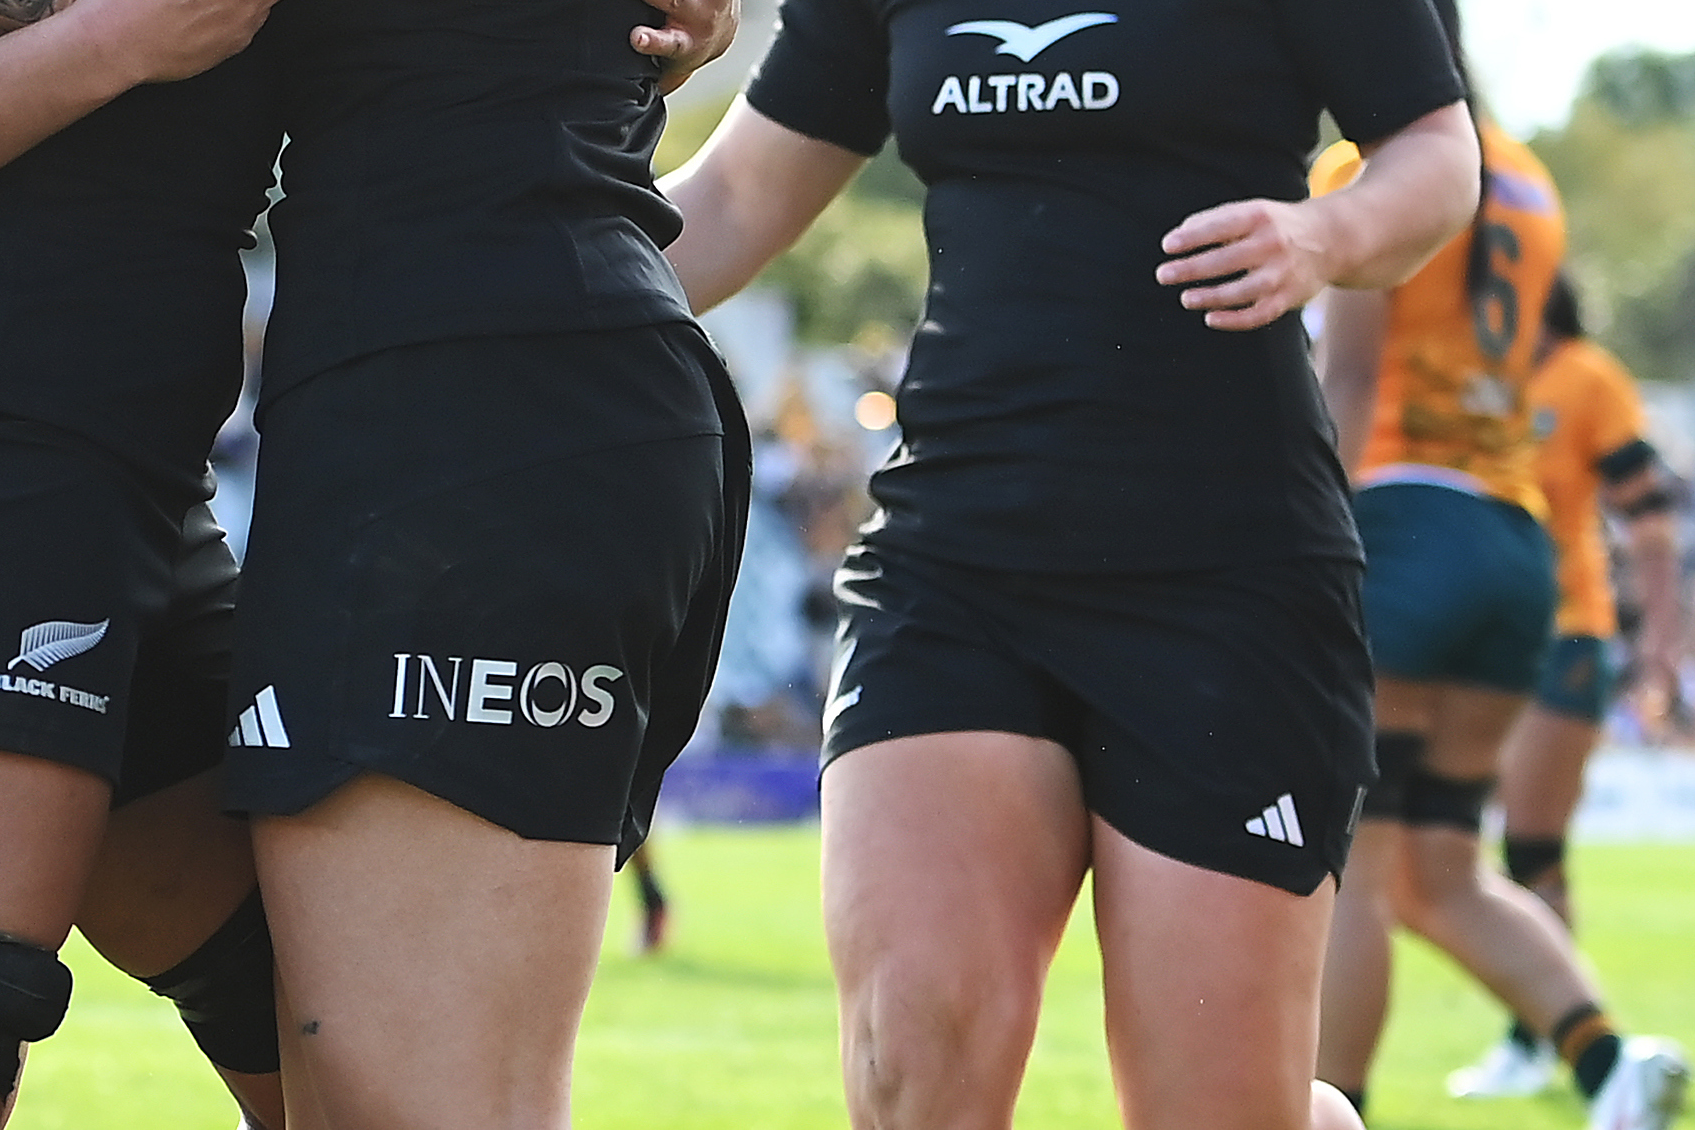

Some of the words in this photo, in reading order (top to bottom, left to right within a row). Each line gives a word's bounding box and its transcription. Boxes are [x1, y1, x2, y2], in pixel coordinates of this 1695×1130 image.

[931, 72, 1120, 114] ALTRAD
[1469, 223, 1521, 363] 6
[388, 653, 624, 727] INEOS
